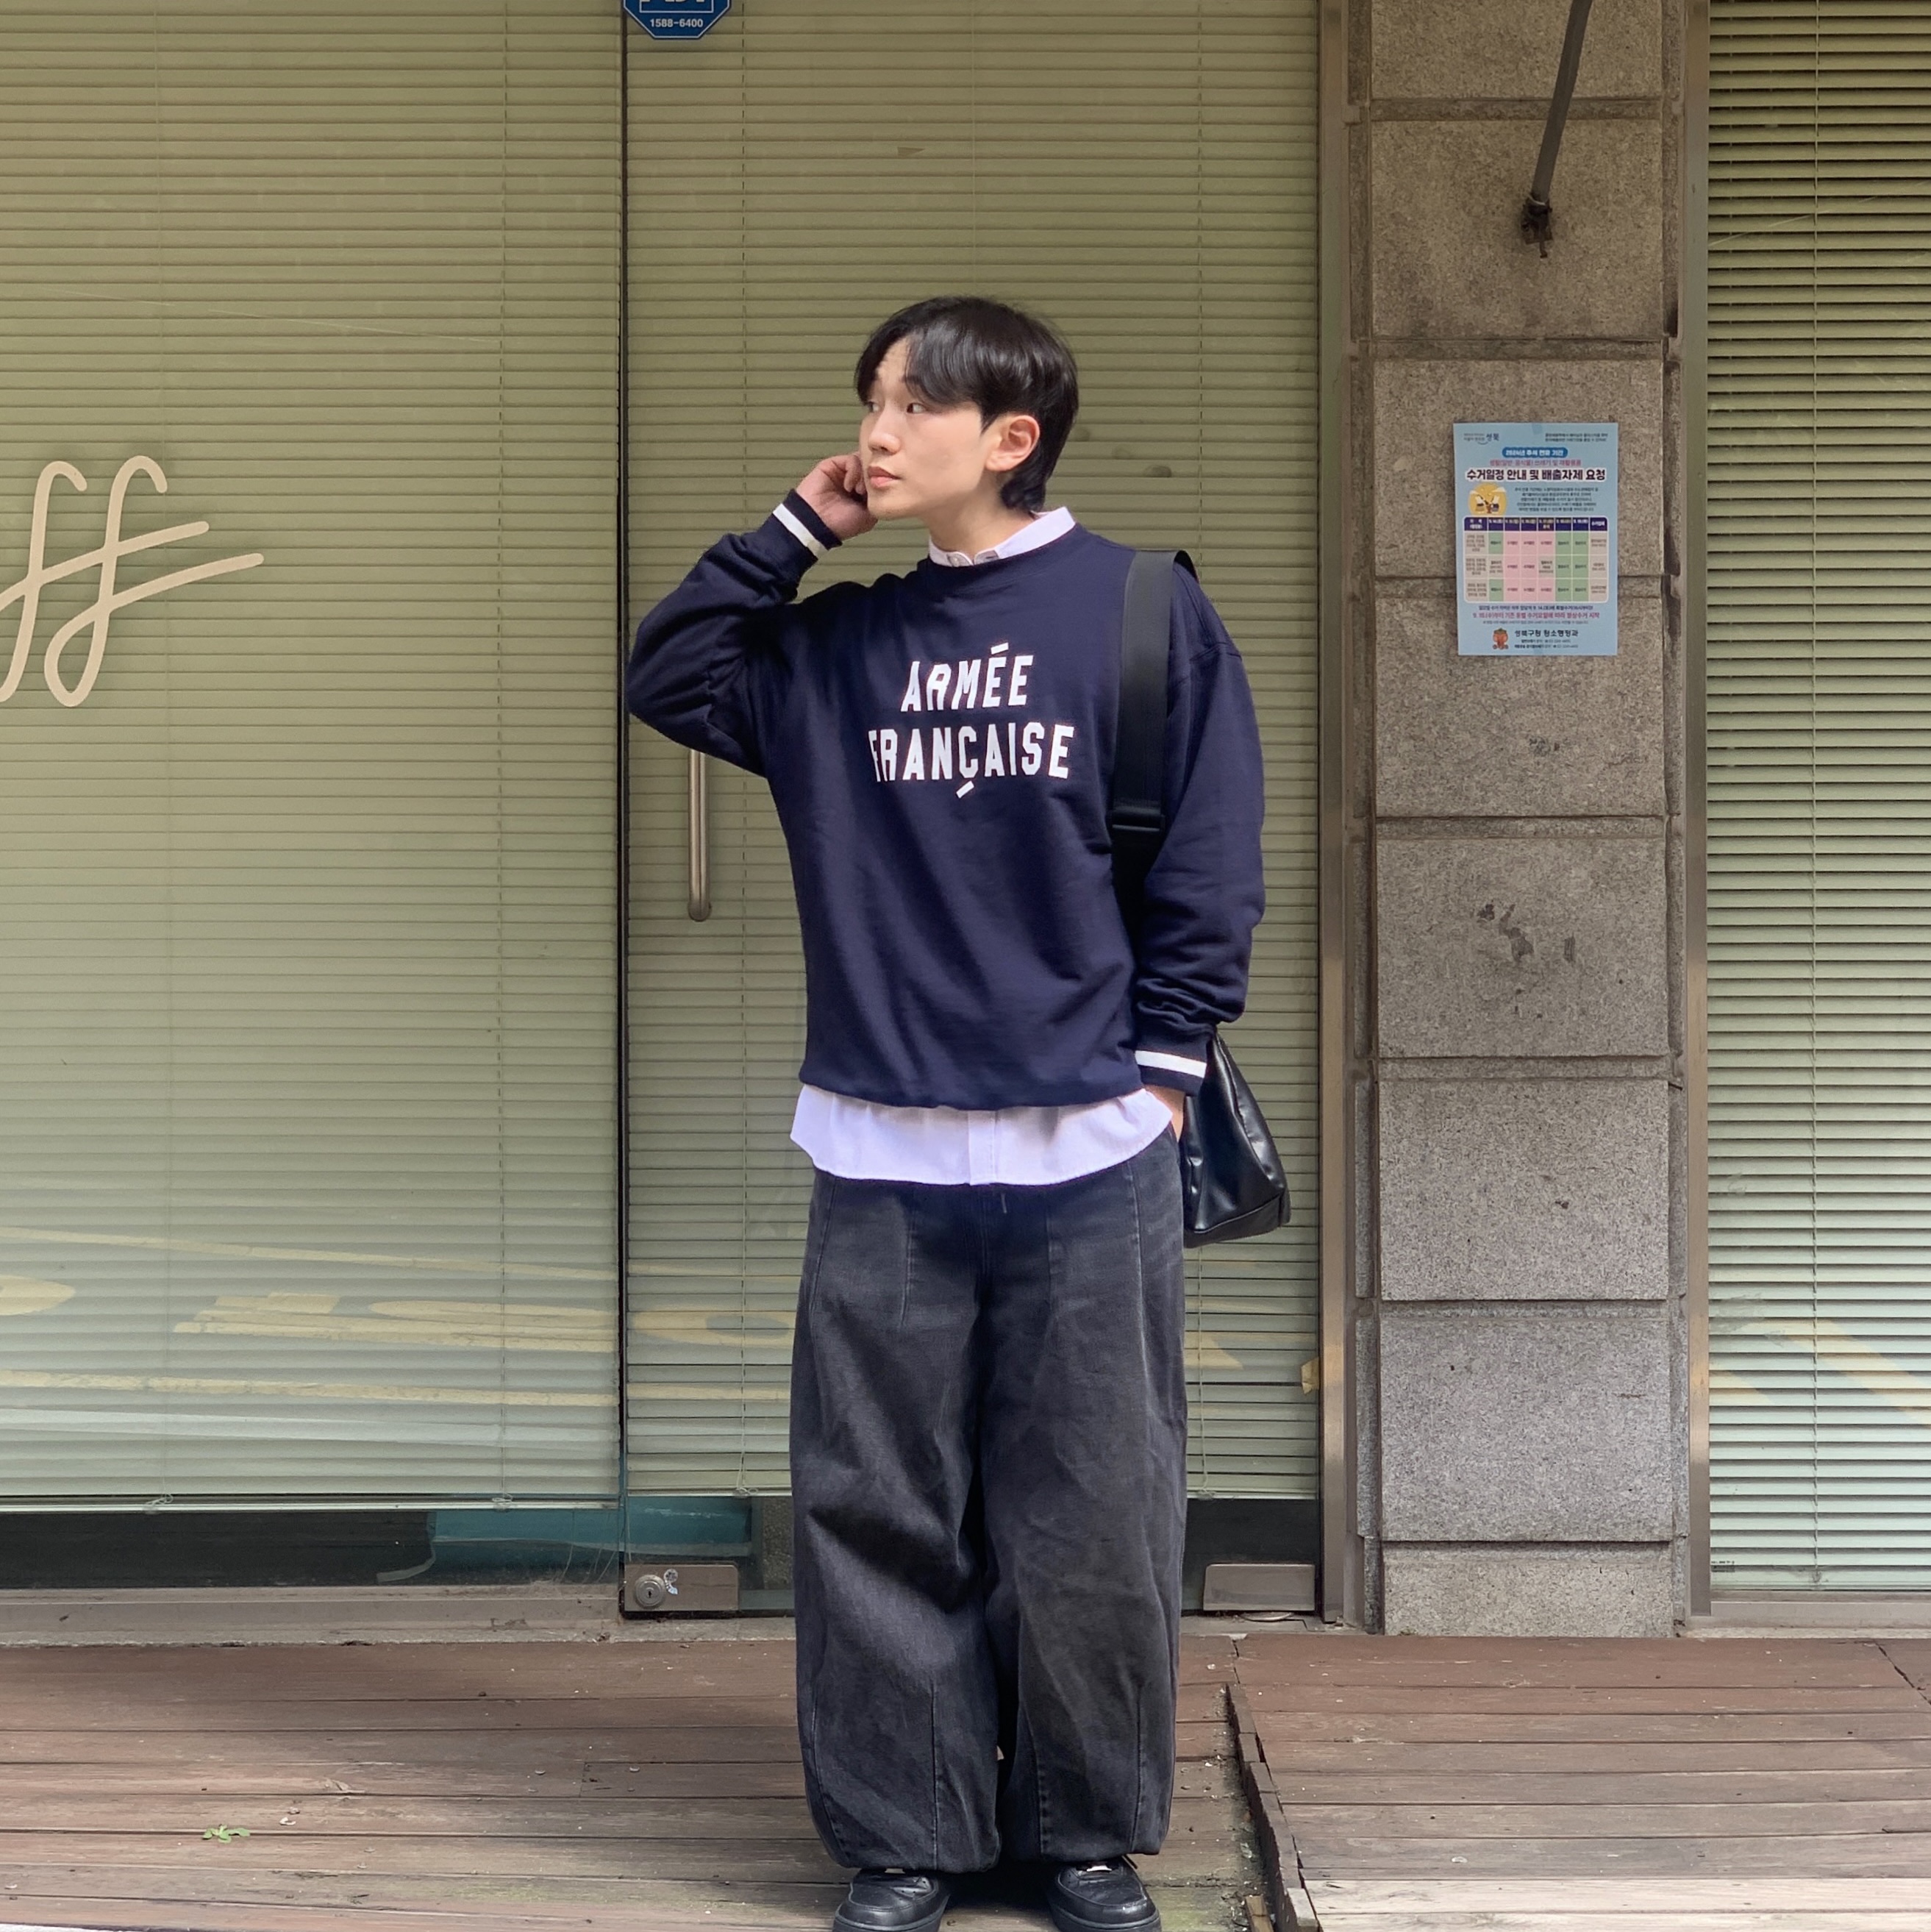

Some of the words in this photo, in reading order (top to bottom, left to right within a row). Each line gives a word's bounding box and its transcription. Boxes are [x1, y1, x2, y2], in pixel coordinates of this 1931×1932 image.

[649, 18, 704, 28] 1588-6400
[1467, 469, 1504, 480] 수거일정
[1507, 469, 1527, 480] 안내
[1530, 469, 1539, 480] 및
[1542, 469, 1583, 480] 배출자제
[1585, 469, 1605, 480] 요청
[901, 642, 1034, 712] ARMÉE
[868, 721, 1074, 799] FRANÇAISE
